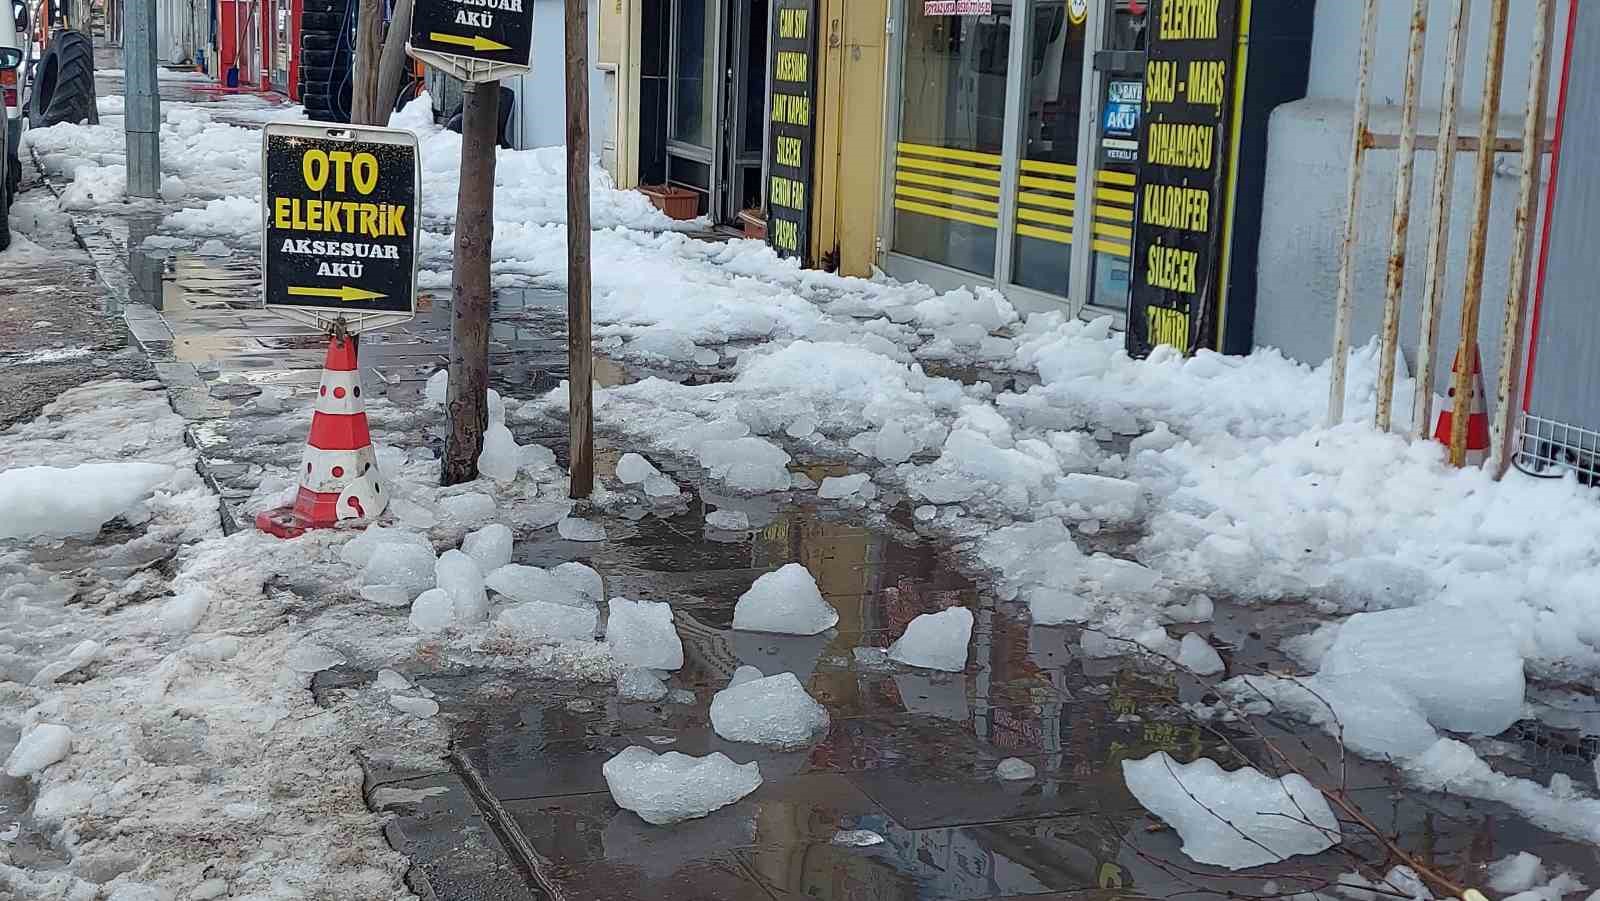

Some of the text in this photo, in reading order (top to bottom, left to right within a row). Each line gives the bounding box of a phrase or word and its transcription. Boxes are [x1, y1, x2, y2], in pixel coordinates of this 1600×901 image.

[454, 10, 494, 28] AKÜ
[780, 8, 794, 38] CAM
[776, 51, 808, 82] AKSESUAR
[1146, 60, 1226, 117] ŞARJ - MARŞ
[772, 93, 787, 122] JANT
[776, 129, 801, 168] SİLECEK
[1147, 113, 1214, 169] DİNAMOSU
[302, 149, 379, 195] OTO
[771, 175, 804, 210] XENON FAR
[1143, 177, 1210, 232] KALORİFER
[275, 197, 407, 239] ELEKTRİK
[775, 218, 797, 251] PASPAS
[280, 238, 400, 259] AKSESUAR
[1147, 236, 1198, 293] SİLECEK
[316, 261, 364, 278] AKÜ
[1146, 301, 1190, 353] TAMİRİ
